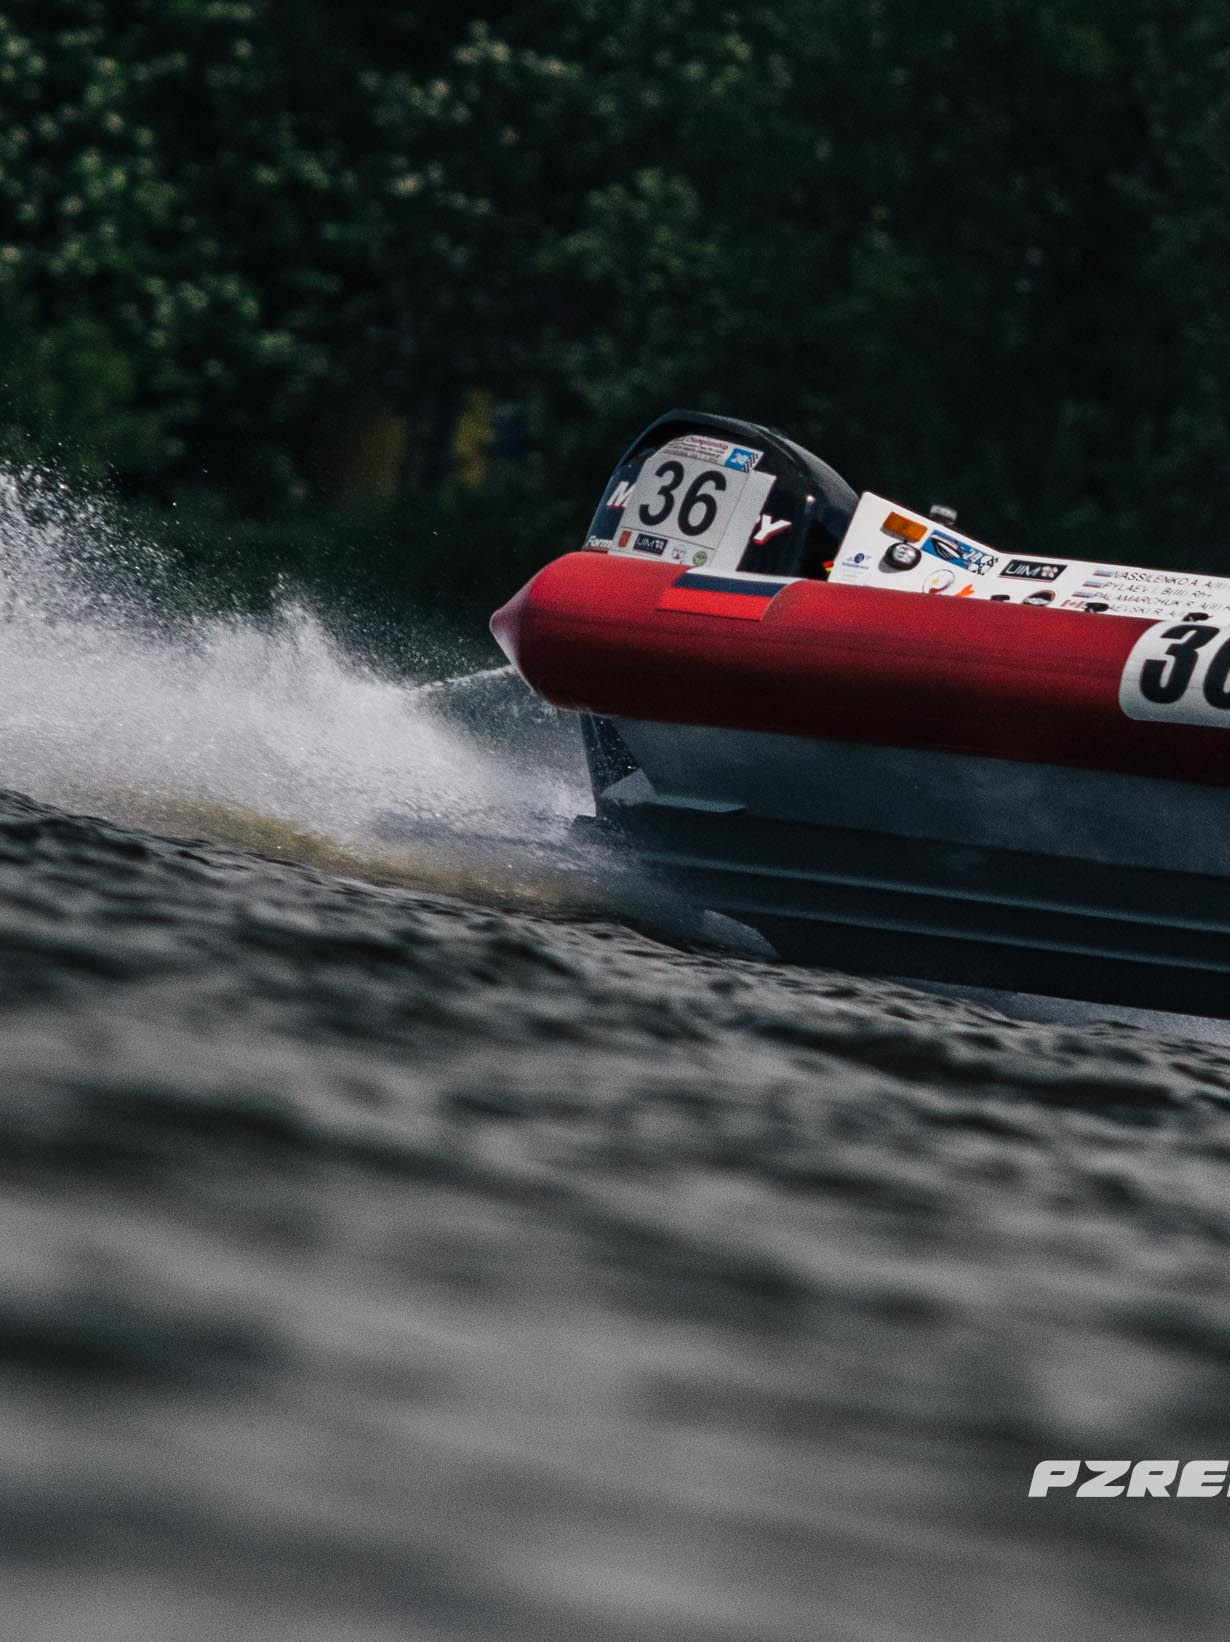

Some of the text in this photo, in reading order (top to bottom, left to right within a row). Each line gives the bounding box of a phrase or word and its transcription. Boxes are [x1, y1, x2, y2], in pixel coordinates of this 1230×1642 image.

[638, 460, 727, 537] 36
[585, 535, 612, 549] Form
[1005, 563, 1040, 576] UIM
